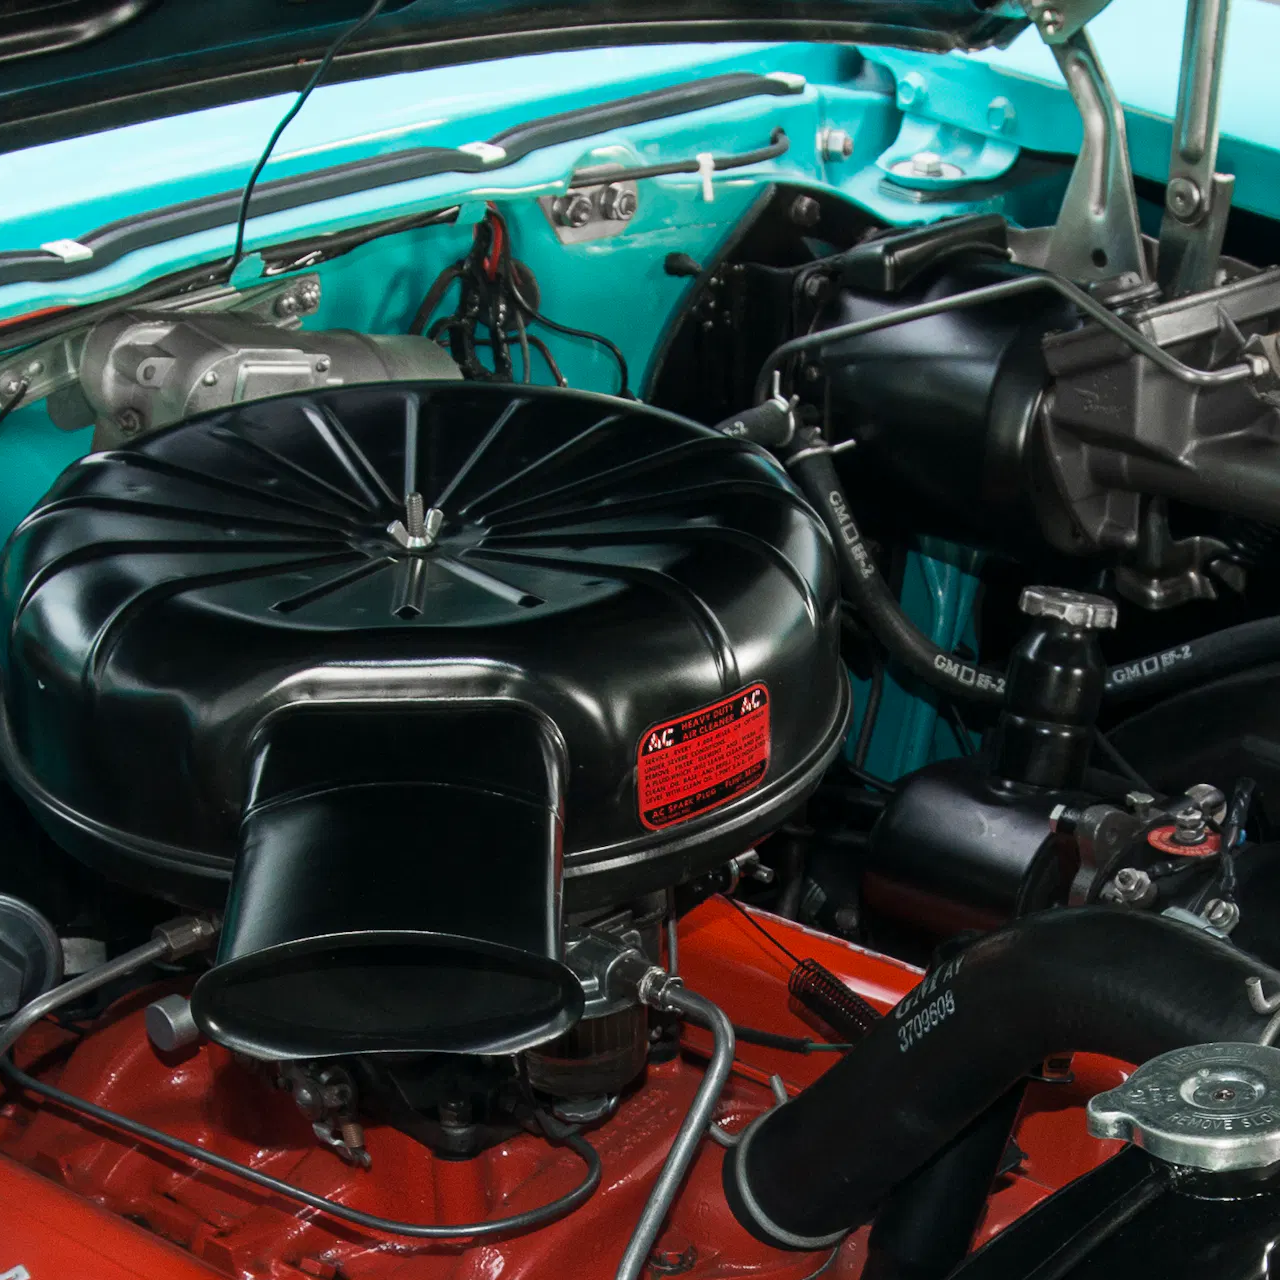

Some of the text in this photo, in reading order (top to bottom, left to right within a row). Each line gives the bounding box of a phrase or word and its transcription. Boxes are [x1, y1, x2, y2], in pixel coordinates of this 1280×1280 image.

[829, 490, 851, 525] GM
[933, 654, 960, 678] GM
[1112, 664, 1142, 684] GM
[740, 689, 760, 715] AC
[681, 714, 710, 730] HEAVY
[682, 713, 733, 739] AIR CLEANER
[648, 728, 674, 751] AC
[898, 989, 956, 1053] 3709608
[1169, 1112, 1234, 1131] REMOVE
